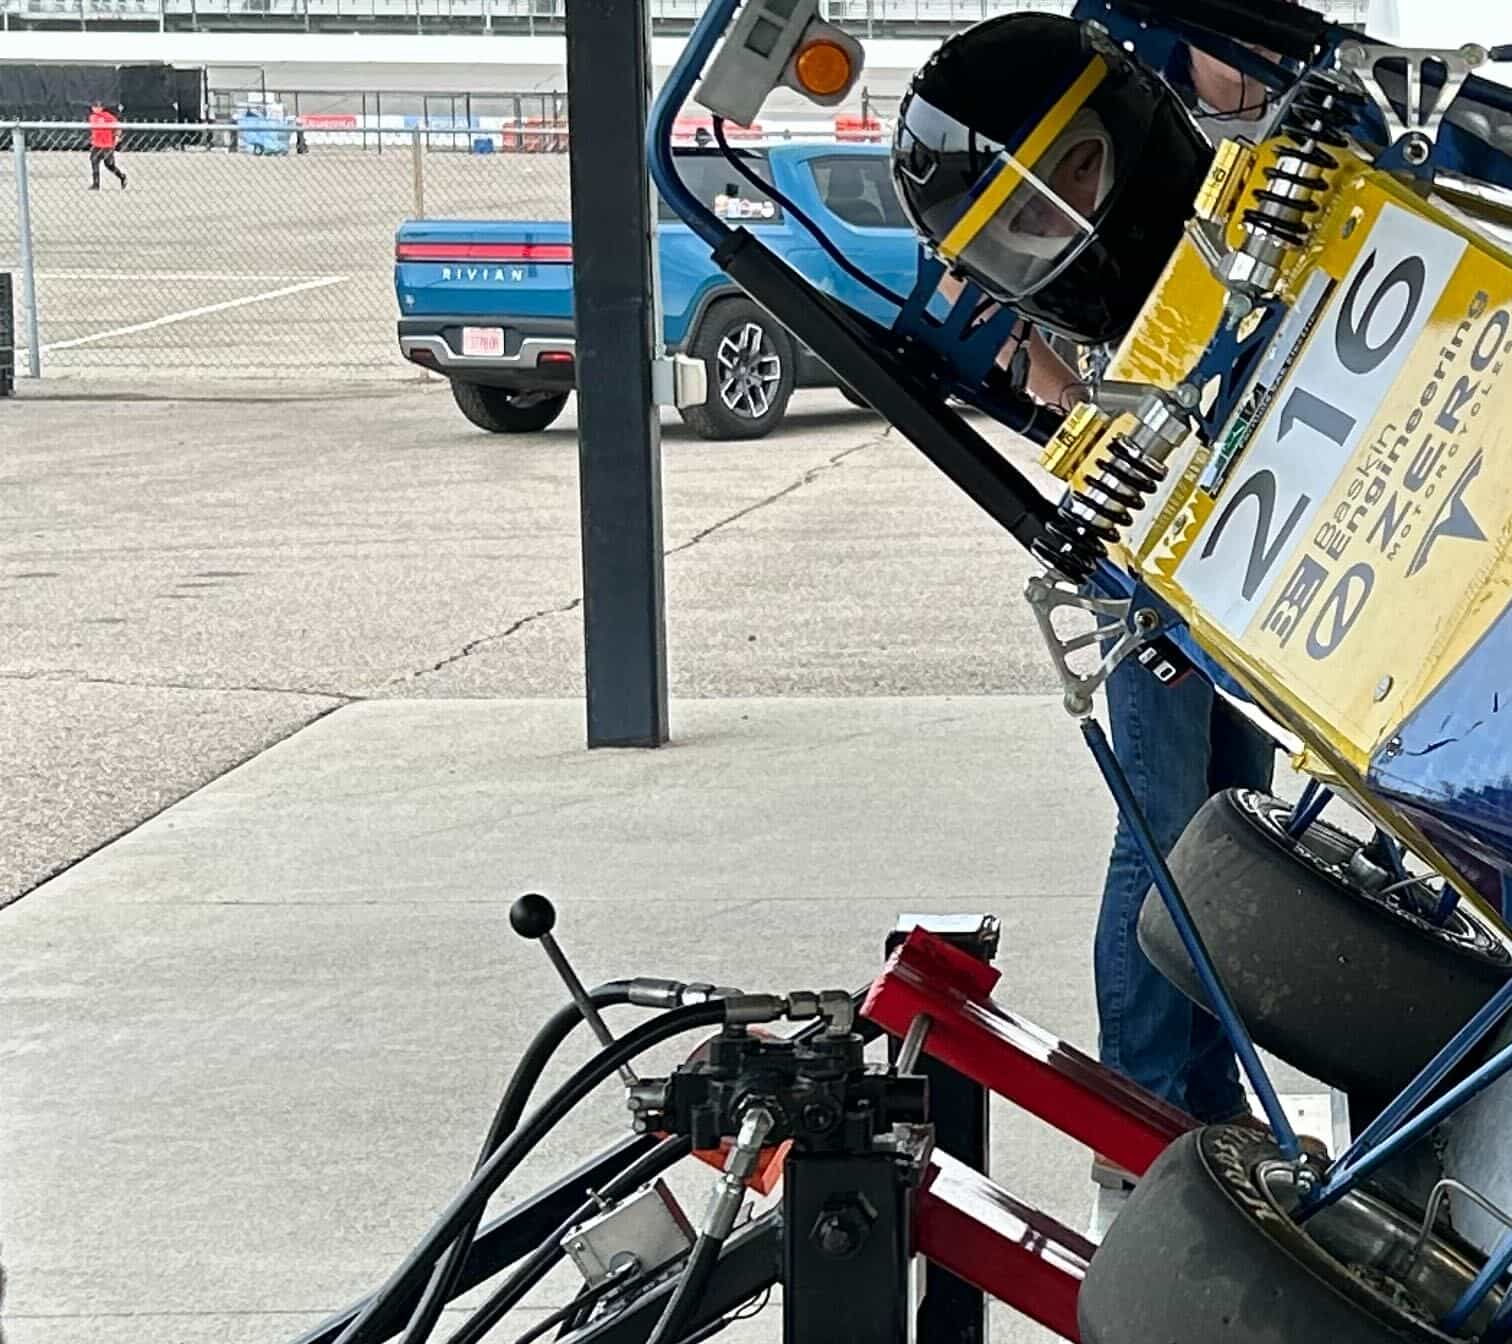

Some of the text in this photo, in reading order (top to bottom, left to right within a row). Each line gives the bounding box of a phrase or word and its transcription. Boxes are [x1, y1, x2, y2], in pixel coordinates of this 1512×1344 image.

[442, 267, 524, 282] RIVIAN
[1201, 247, 1426, 603] 216
[1314, 422, 1397, 548] Baskin
[1331, 288, 1489, 560] Engineering
[1368, 308, 1512, 554] ZERO
